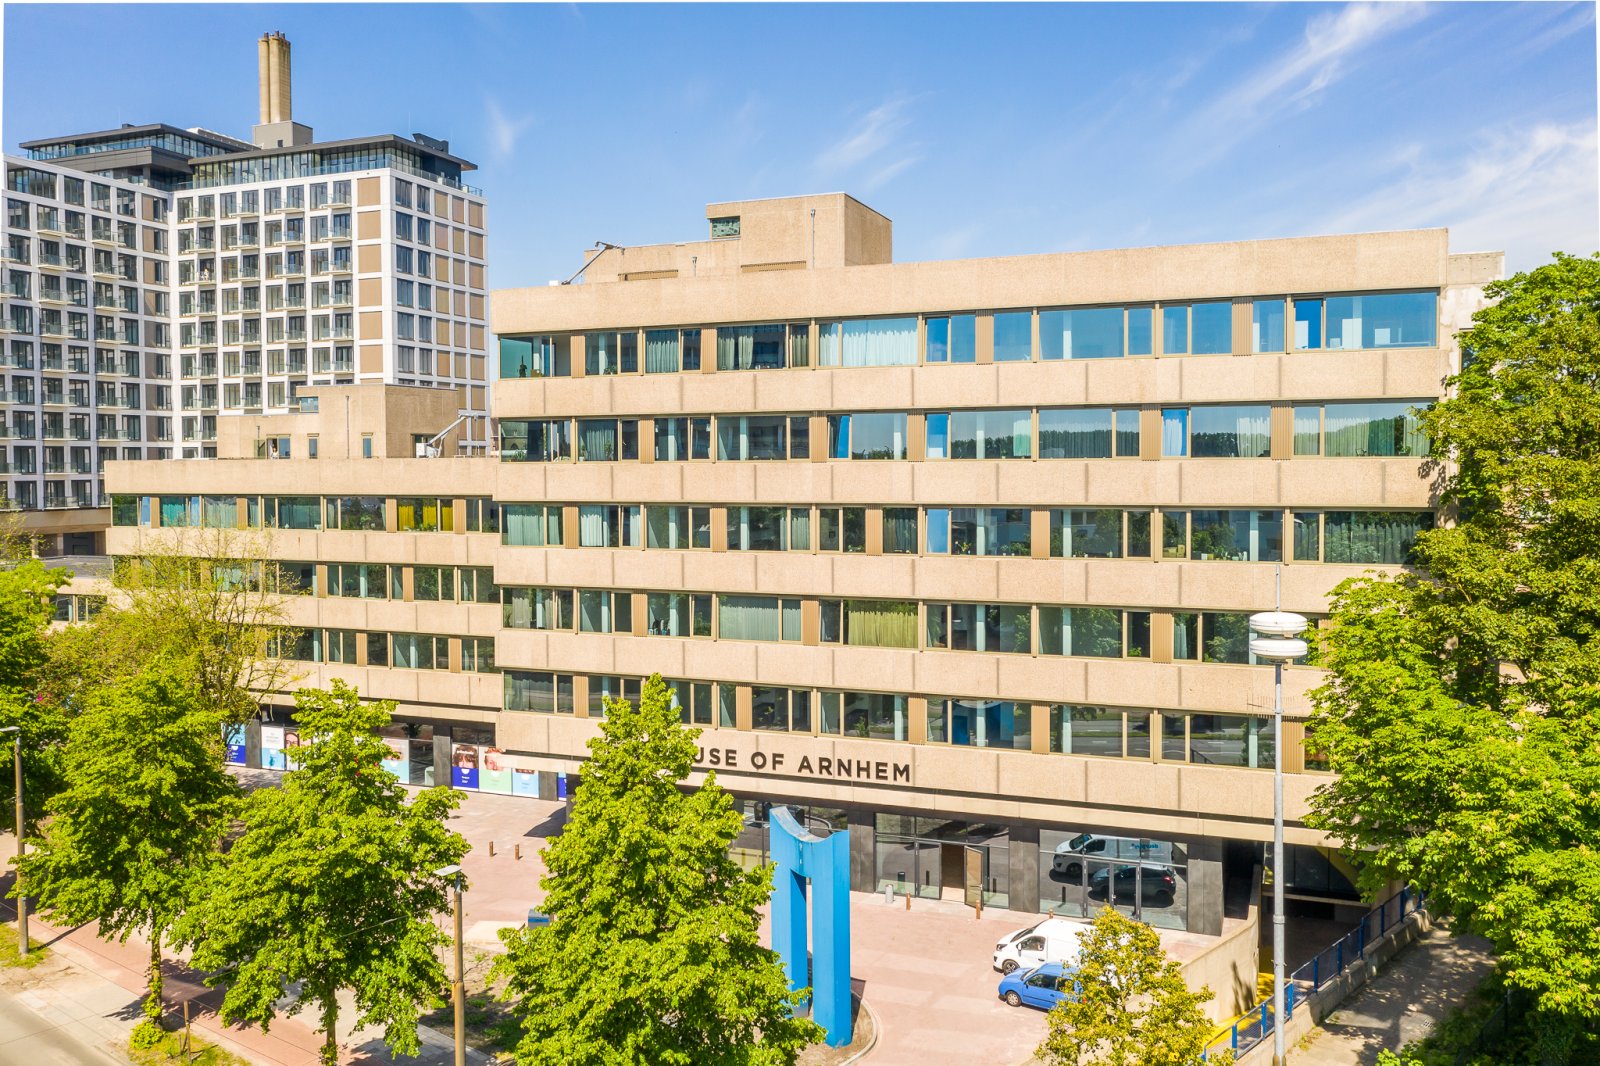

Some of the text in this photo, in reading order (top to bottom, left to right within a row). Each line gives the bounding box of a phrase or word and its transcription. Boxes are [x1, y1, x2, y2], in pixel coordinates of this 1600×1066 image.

[694, 747, 910, 782] USE OF ARNHEM
